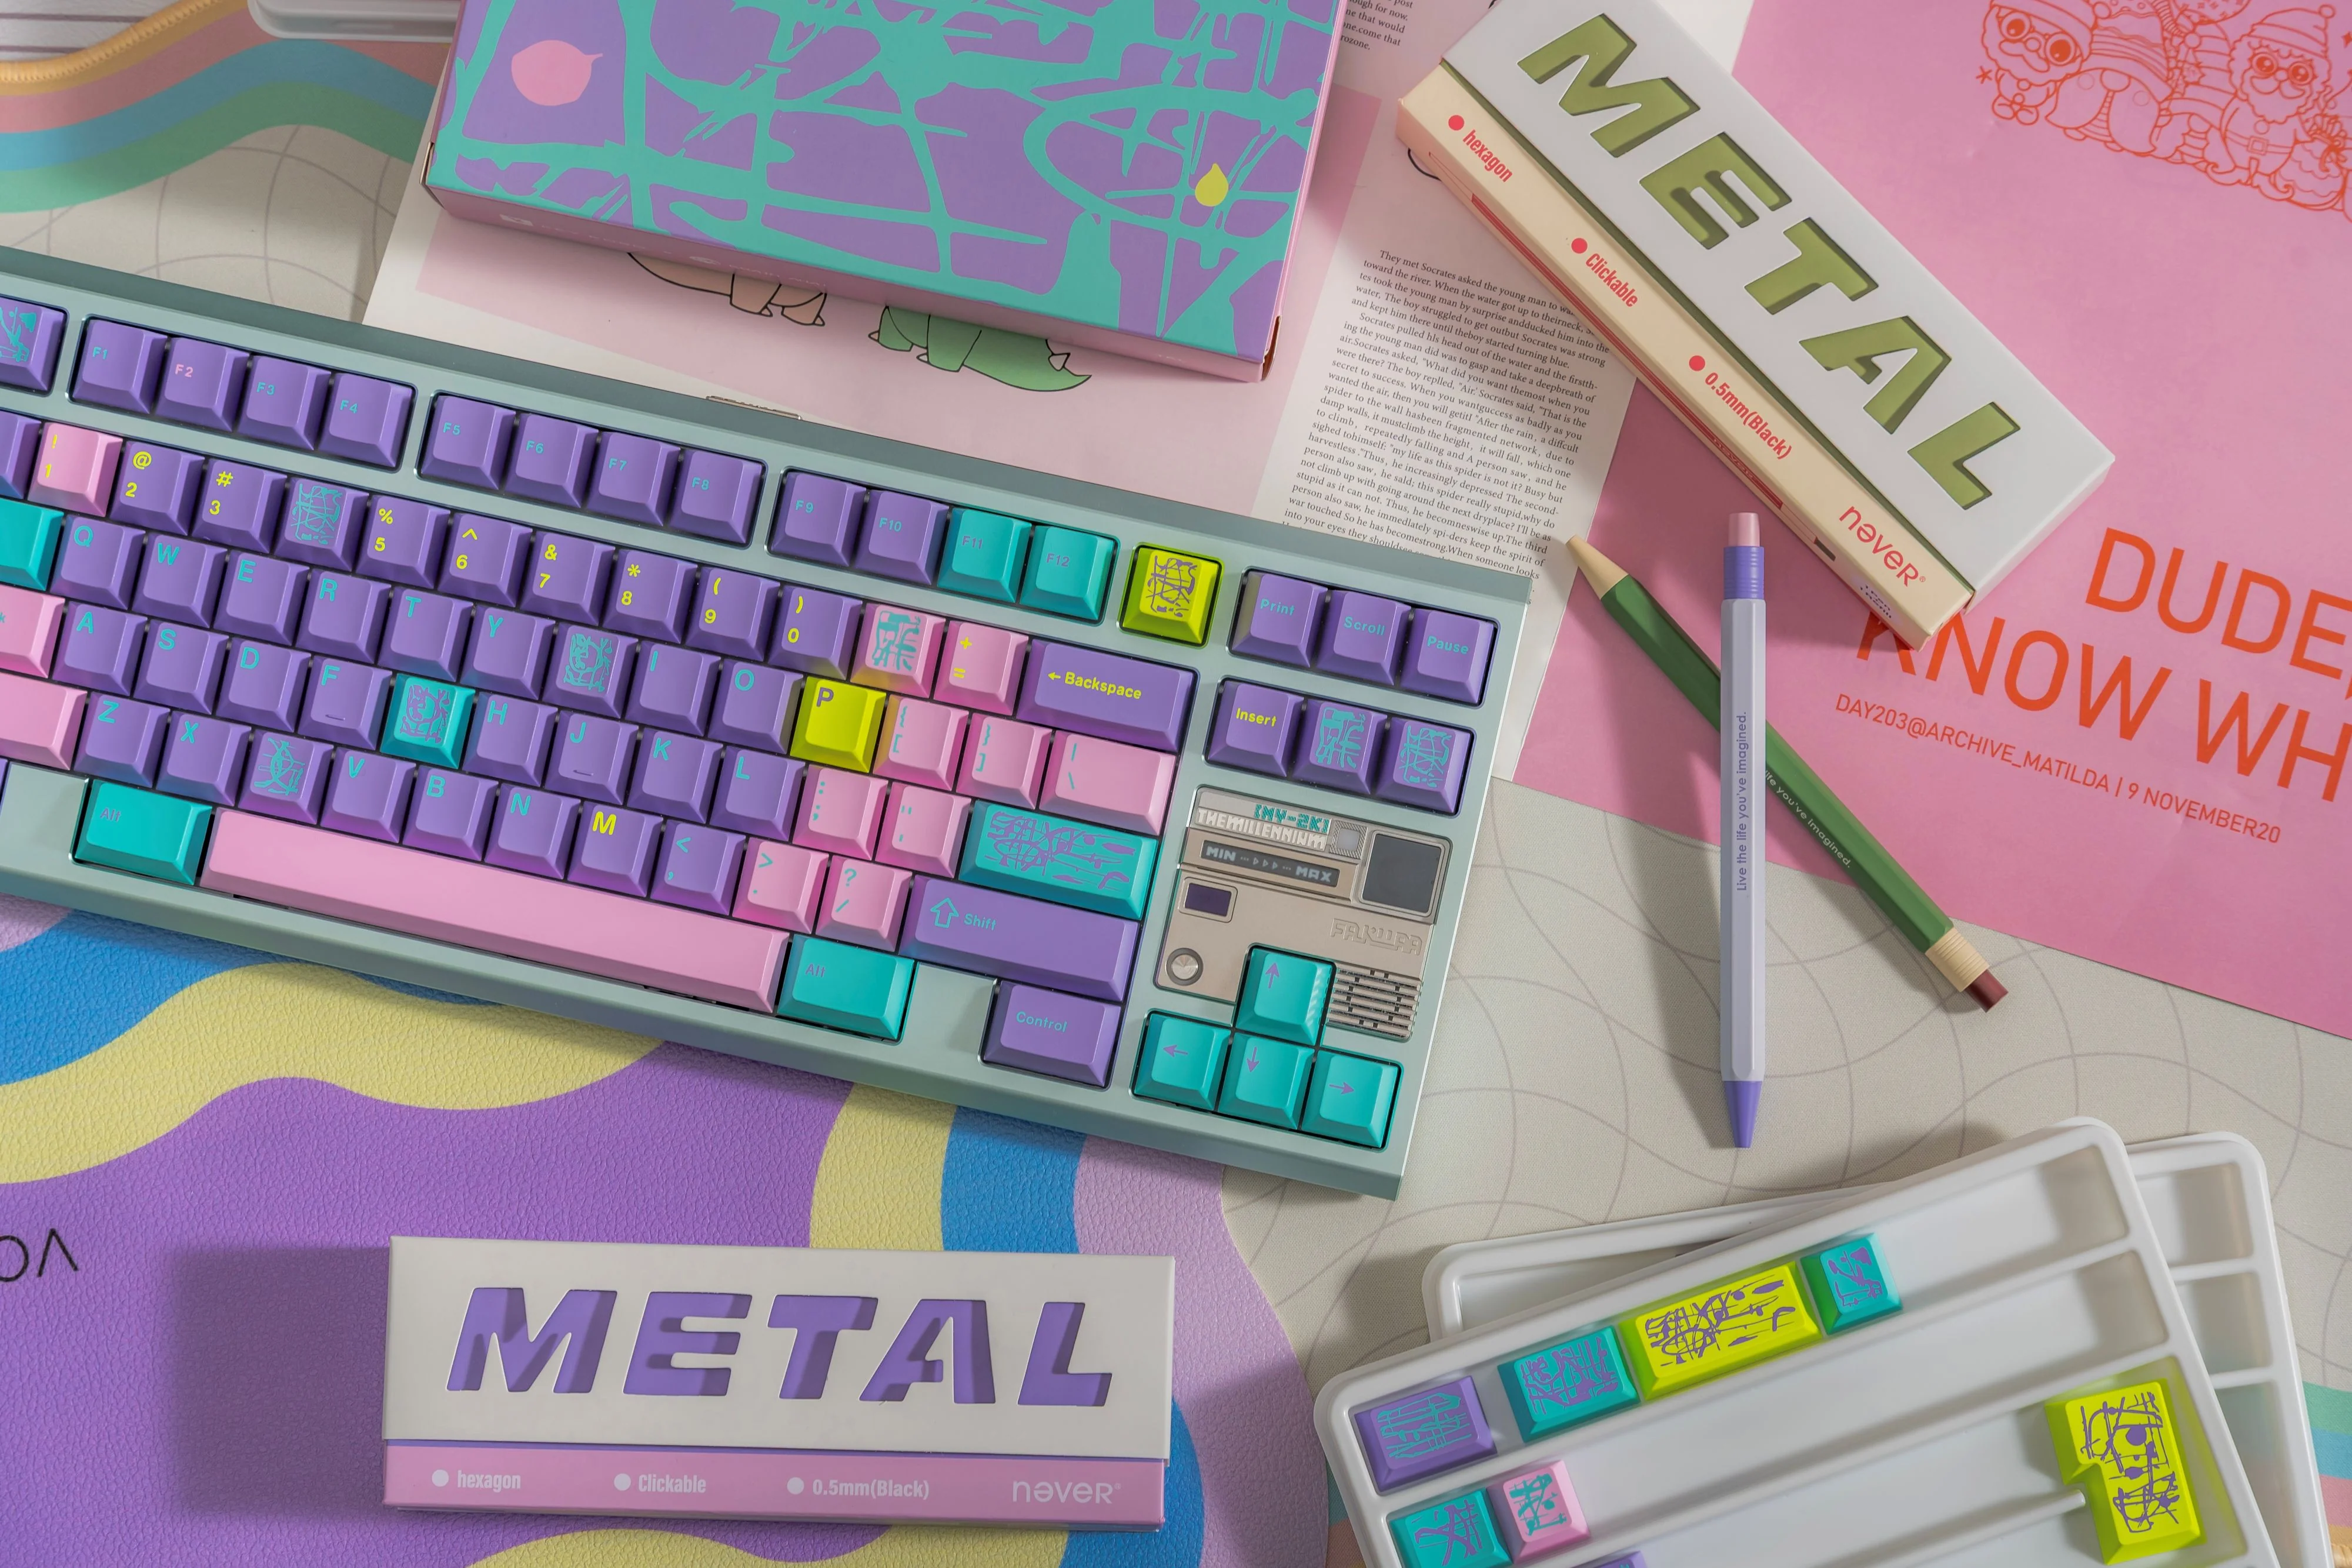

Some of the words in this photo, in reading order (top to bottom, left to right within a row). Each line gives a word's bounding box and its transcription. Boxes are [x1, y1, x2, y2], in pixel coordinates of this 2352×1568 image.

[1358, 10, 1375, 24] that
[1378, 19, 1405, 34] would
[1375, 2, 1388, 14] for
[1389, 10, 1408, 21] now.
[1384, 34, 1401, 46] that
[1517, 13, 2021, 510] METAL
[1463, 130, 1512, 182] hexagon
[1586, 253, 1638, 307] Clickable
[1705, 372, 1792, 459] 0.5mm(Black)
[1359, 272, 1372, 282] tes
[1372, 276, 1393, 289] took
[1394, 282, 1408, 293] the
[1408, 287, 1436, 304] young
[1438, 296, 1457, 308] man
[1459, 300, 1471, 313] by
[1471, 306, 1507, 322] surprise
[1507, 317, 1556, 337] andducked
[1556, 329, 1574, 343] him
[1575, 336, 1594, 349] into
[1595, 342, 1610, 353] the
[1351, 297, 1369, 308] and
[1368, 300, 1388, 315] kept
[1389, 306, 1407, 320] him
[1408, 313, 1431, 327] there
[1432, 322, 1454, 333] until
[1454, 326, 1484, 345] theboy
[1484, 337, 1515, 352] started
[1515, 346, 1548, 365] turning
[93, 347, 108, 359] F1
[175, 364, 193, 377] F2
[257, 382, 275, 395] F3
[1450, 366, 1466, 379] did
[1466, 373, 1484, 384] you
[1486, 379, 1508, 391] want
[1509, 385, 1545, 402] themost
[1548, 396, 1571, 410] when
[1572, 404, 1590, 416] you
[340, 400, 358, 413] F4
[443, 423, 460, 435] F5
[1323, 385, 1353, 399] spider
[1355, 393, 1364, 402] to
[1366, 396, 1382, 408] the
[1384, 403, 1404, 414] wall
[1404, 407, 1442, 426] hasbeen
[1444, 419, 1498, 443] fragmented
[1545, 449, 1563, 462] due
[1565, 456, 1575, 466] to
[526, 440, 543, 453] F6
[46, 464, 51, 477] 1
[133, 452, 152, 469] @
[609, 458, 627, 470] F7
[125, 482, 137, 497] 2
[216, 472, 233, 487] #
[692, 477, 709, 490] F8
[209, 500, 220, 514] 3
[796, 500, 814, 513] F9
[1299, 459, 1315, 469] not
[1317, 462, 1341, 477] climb
[1342, 472, 1355, 483] up
[1357, 476, 1376, 489] with
[1376, 483, 1402, 499] going
[1402, 492, 1435, 507] around
[1436, 500, 1451, 511] the
[1451, 506, 1471, 518] next
[1529, 527, 1541, 539] be
[379, 509, 393, 524] %
[879, 517, 902, 531] F10
[1291, 484, 1322, 499] person
[1324, 493, 1342, 505] also
[1363, 504, 1375, 516] he
[1469, 536, 1491, 553] keep
[1492, 544, 1507, 556] the
[1508, 551, 1532, 564] spirit
[1534, 558, 1546, 567] of
[74, 526, 93, 547] Q
[375, 537, 385, 551] 5
[962, 536, 982, 549] F11
[158, 543, 179, 565] W
[456, 555, 467, 569] 6
[544, 544, 557, 560] &
[1047, 553, 1070, 567] F12
[238, 560, 256, 582] E
[540, 573, 550, 588] 7
[319, 579, 338, 601] R
[621, 591, 632, 605] 8
[406, 596, 421, 617] T
[705, 609, 716, 623] 9
[1261, 599, 1294, 615] Print
[76, 611, 93, 633] A
[489, 616, 503, 637] Y
[1344, 616, 1385, 636] Scroll
[159, 629, 176, 650] S
[1427, 636, 1468, 654] Pause
[240, 647, 259, 669] D
[322, 665, 340, 686] F
[735, 669, 754, 690] O
[1065, 671, 1141, 699] Backspace
[817, 687, 834, 706] P
[98, 700, 119, 723] Z
[487, 701, 507, 724] H
[1236, 708, 1276, 727] Insert
[181, 721, 198, 743] X
[570, 722, 586, 743] J
[653, 738, 671, 760] K
[1737, 712, 1749, 774] imagined.
[349, 757, 365, 778] V
[736, 757, 750, 780] L
[1836, 694, 2109, 793] DAY203@ARCHIVE_MATILDA
[2129, 783, 2139, 799] 9
[2144, 791, 2280, 844] NOVEMBER20
[427, 775, 445, 797] B
[511, 793, 530, 815] N
[1737, 778, 1749, 820] you've
[100, 808, 121, 821] Alt
[593, 811, 616, 835] M
[1737, 824, 1747, 841] life
[1776, 787, 1807, 819] you've
[1808, 818, 1852, 868] imagined.
[1206, 845, 1235, 861] MIN
[1296, 865, 1332, 882] MAX
[1737, 844, 1747, 864] the
[1737, 868, 1747, 891] Live
[964, 913, 996, 930] Shift
[806, 963, 825, 977] Alt
[1016, 1011, 1067, 1032] Control
[446, 1288, 1112, 1406] METAL
[457, 1470, 520, 1492] hexagon
[638, 1473, 706, 1494] Clickable
[813, 1477, 930, 1500] 0.5mm(Black)
